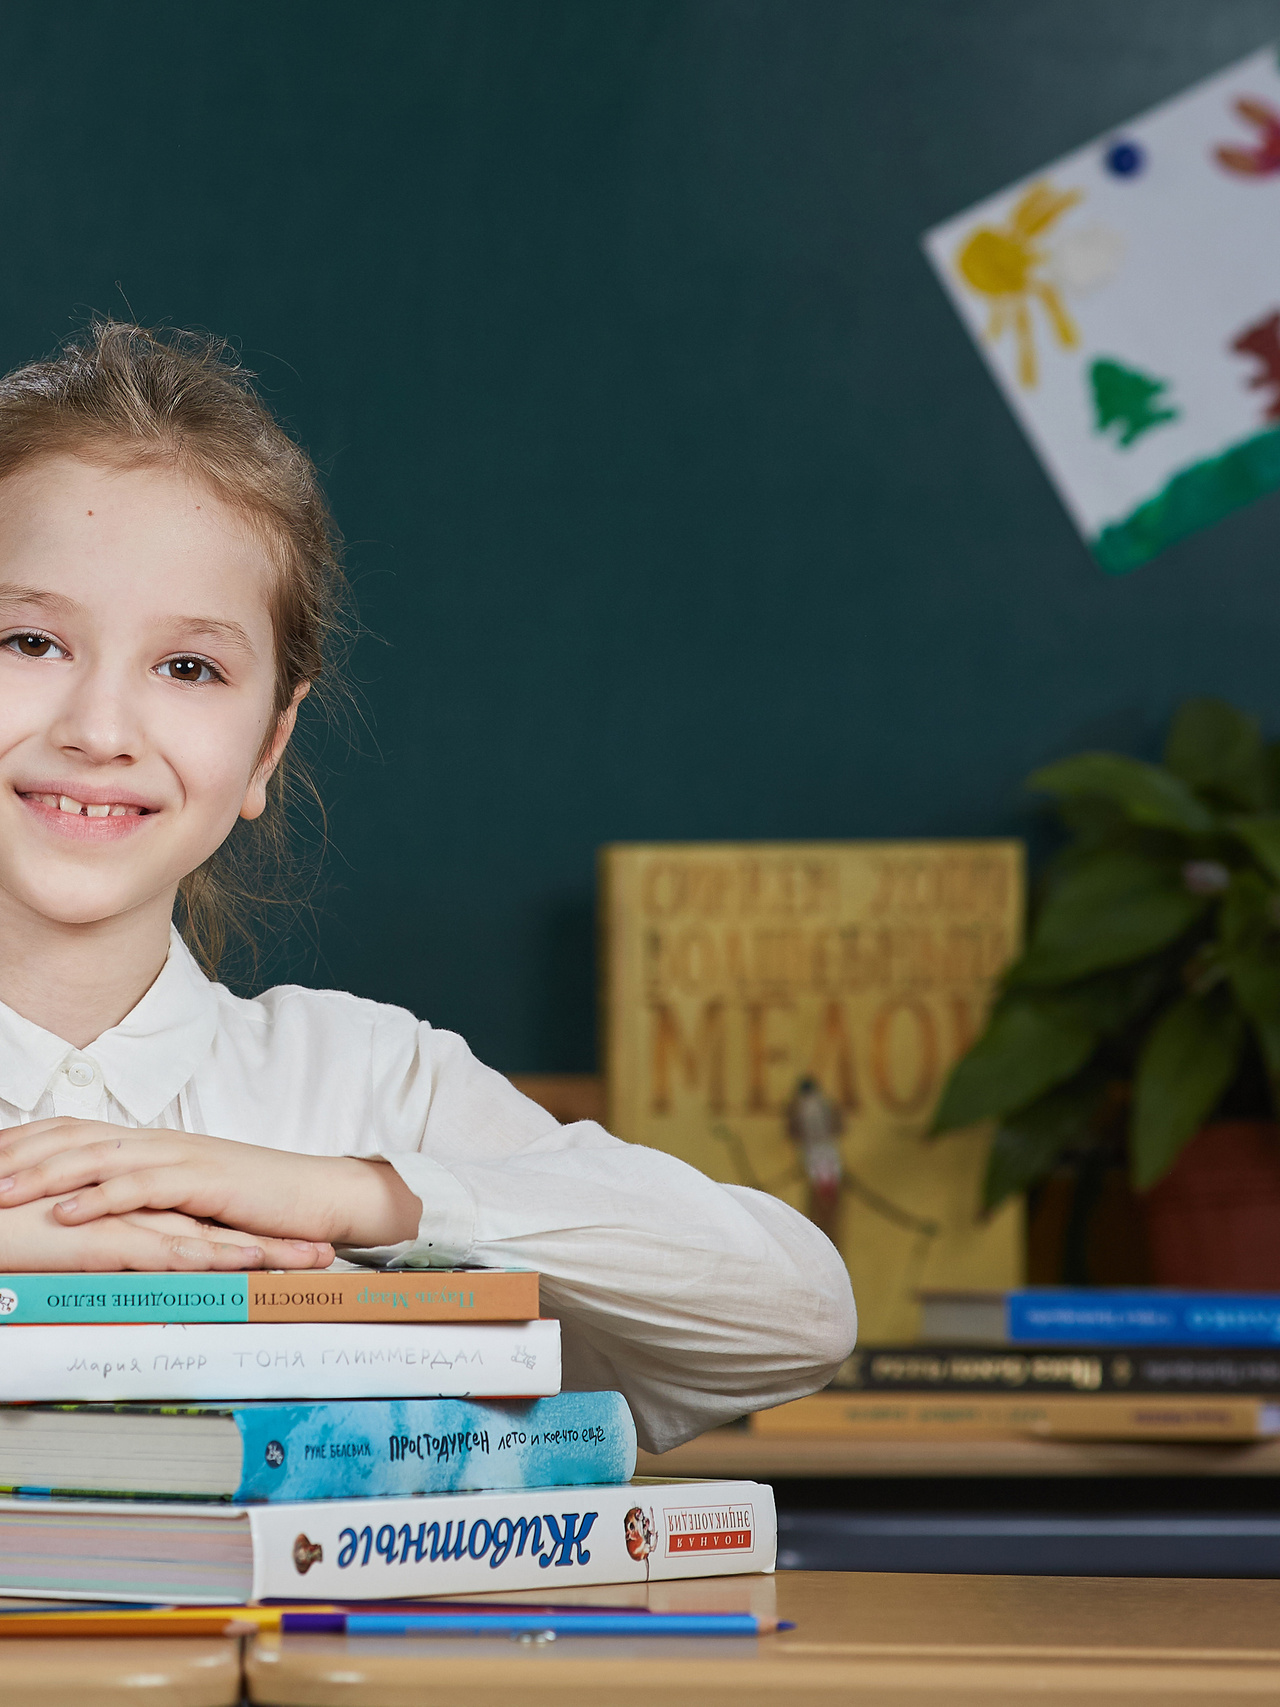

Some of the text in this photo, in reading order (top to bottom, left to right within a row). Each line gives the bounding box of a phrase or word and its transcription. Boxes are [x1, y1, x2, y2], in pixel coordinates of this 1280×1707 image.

[47, 1286, 475, 1308] Пауль Маар НОВОСТИ О ГОСПОДИНЕ БЕЛЛО
[66, 1348, 484, 1379] Мария ПАРР ТОНЯ ГЛИММЕРДАЛ
[304, 1443, 327, 1460] РУНЕ
[668, 1506, 751, 1532] ЭНЦИКЛОПЕДИЯ
[337, 1511, 599, 1569] Животные
[676, 1534, 745, 1548] ПОЛНАЯ
